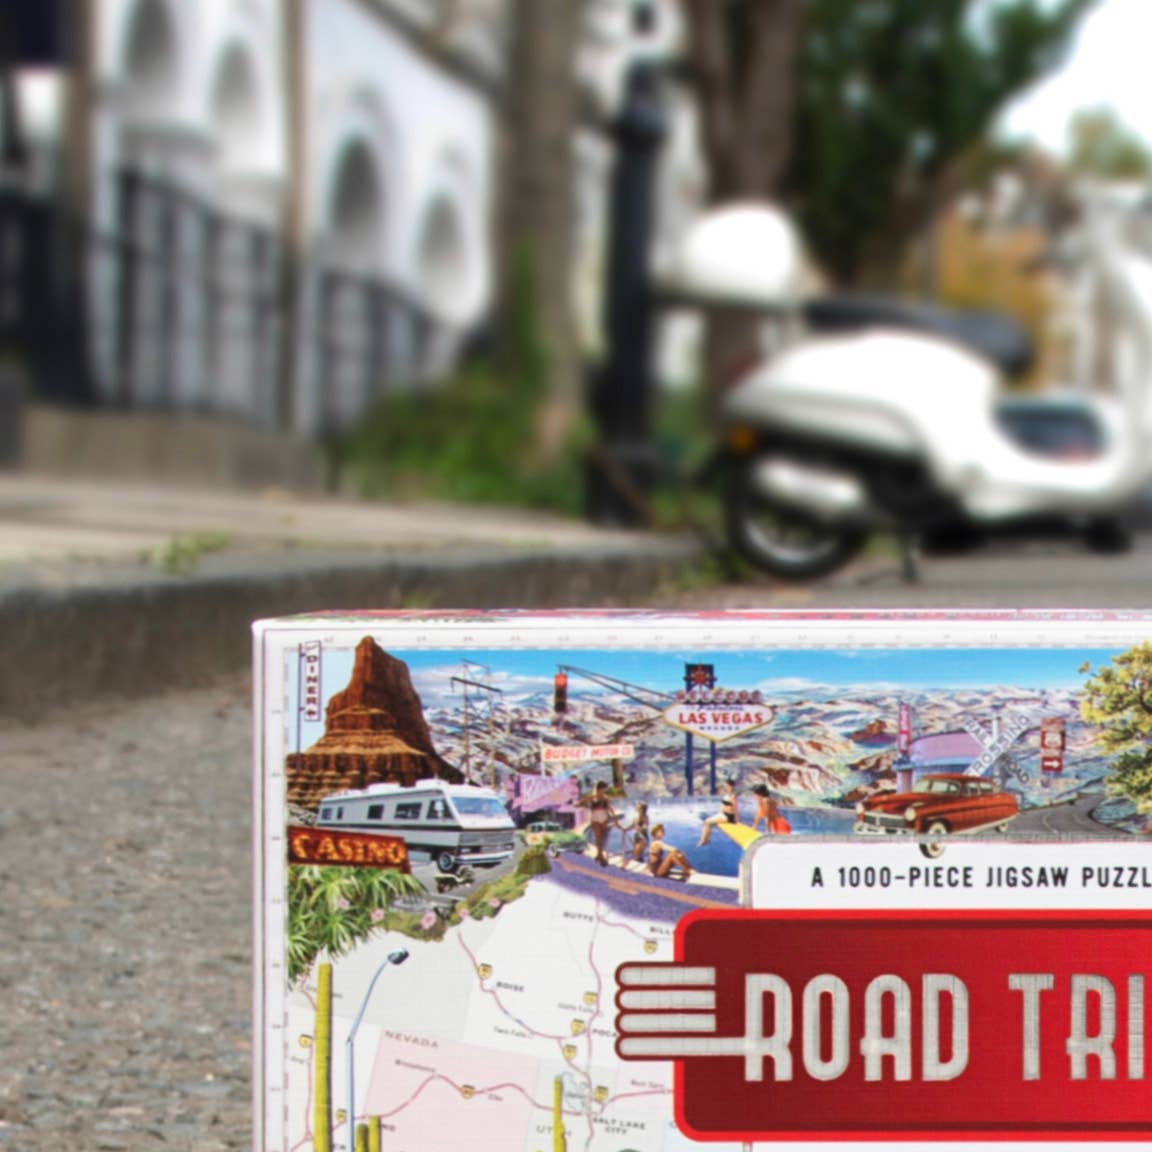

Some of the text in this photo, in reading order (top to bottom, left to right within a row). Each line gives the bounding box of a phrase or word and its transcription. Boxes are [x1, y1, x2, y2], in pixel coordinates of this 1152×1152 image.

[305, 654, 318, 705] DINER
[678, 711, 764, 725] LAS VEGAS
[291, 832, 407, 865] CASINO
[811, 867, 824, 889] A
[838, 866, 973, 889] 1000-PIECE
[986, 866, 1069, 889] JIGSAW
[384, 1029, 439, 1049] NEVADA
[744, 972, 970, 1082] ROAD
